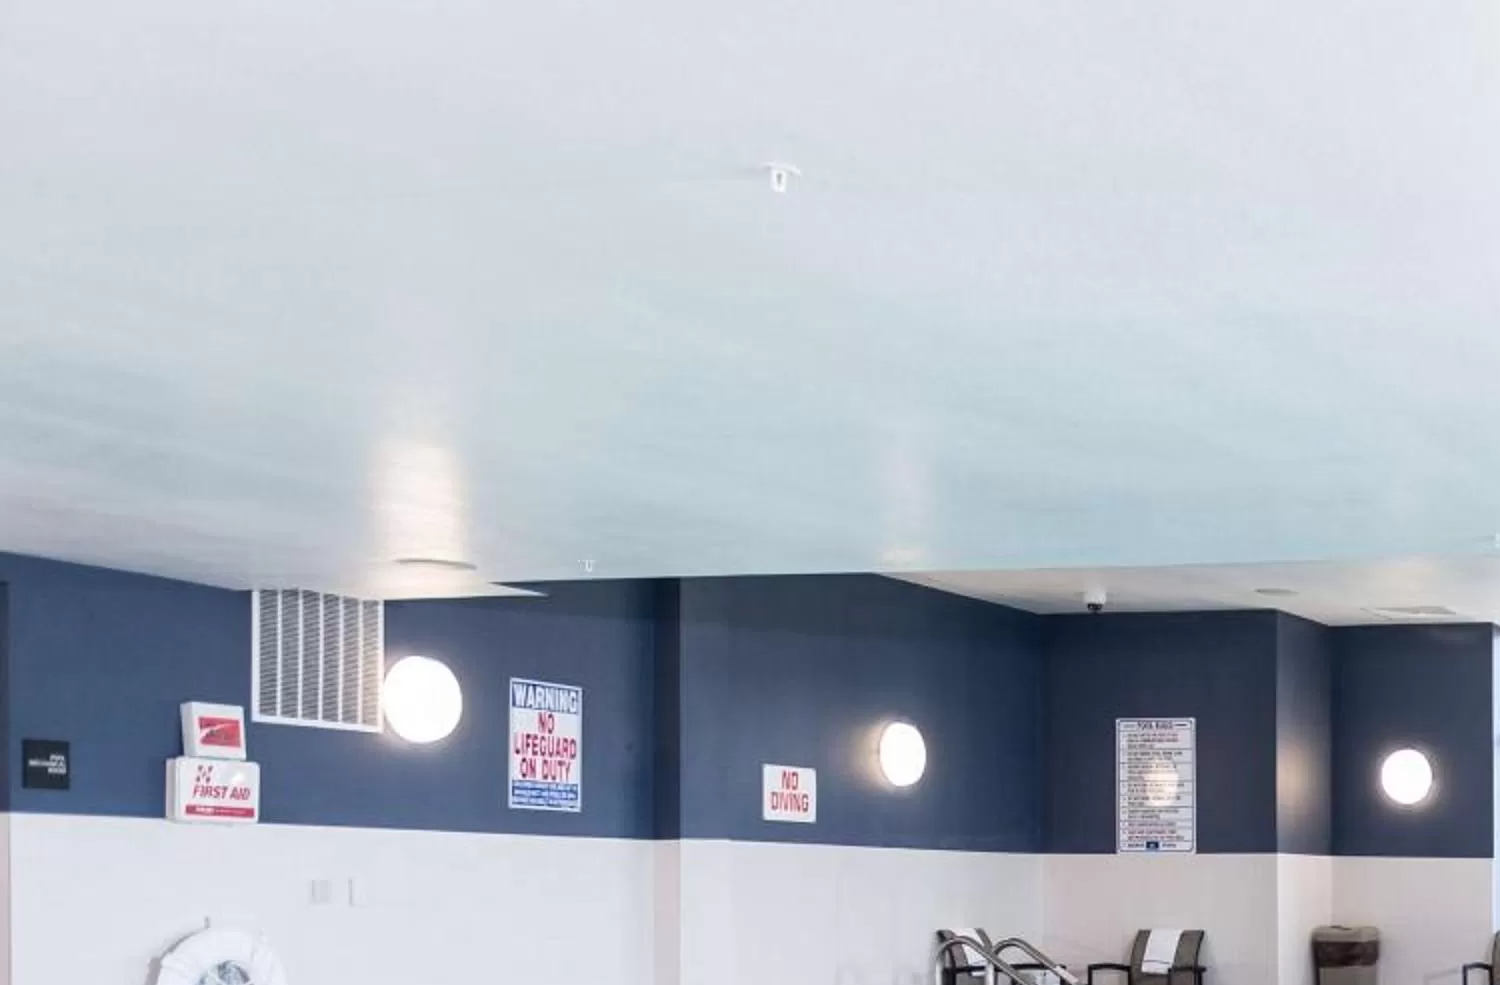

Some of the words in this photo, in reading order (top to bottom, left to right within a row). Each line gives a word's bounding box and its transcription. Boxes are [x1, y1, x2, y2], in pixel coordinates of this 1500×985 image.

[513, 683, 577, 713] WARNING
[538, 712, 555, 734] NO
[515, 732, 577, 760] LIFEGUARD
[520, 757, 537, 778] ON
[542, 760, 571, 783] DUTY
[782, 770, 799, 790] NO
[193, 785, 228, 799] FIRST
[229, 786, 251, 801] AID
[771, 791, 809, 813] DIVING
